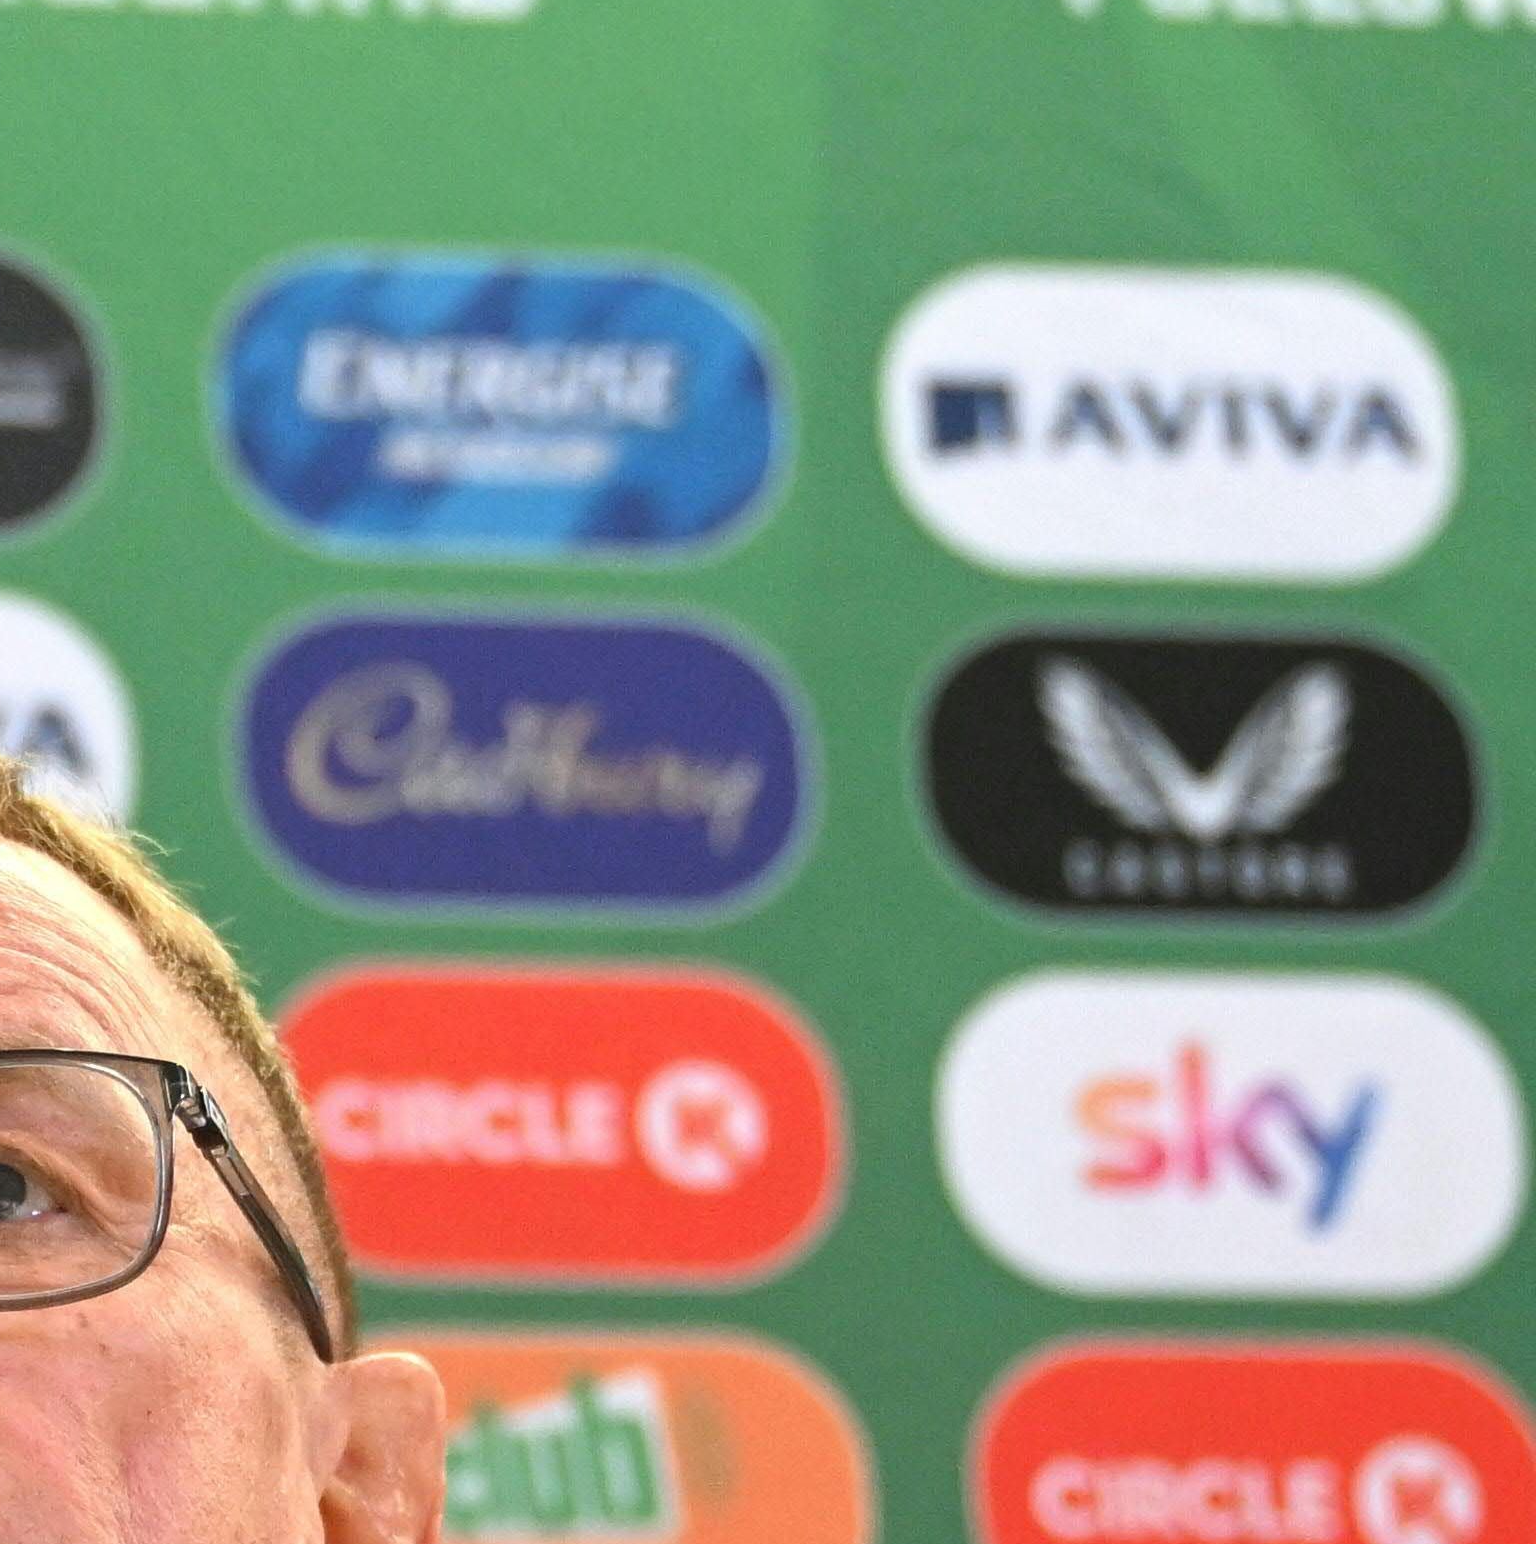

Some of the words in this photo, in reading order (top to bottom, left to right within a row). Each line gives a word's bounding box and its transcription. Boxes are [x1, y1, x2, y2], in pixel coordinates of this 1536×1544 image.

[1048, 376, 1424, 468] AVIVA
[281, 656, 764, 855] Cadbury
[313, 1077, 624, 1167] CIRCLE
[1074, 1038, 1385, 1241] sky
